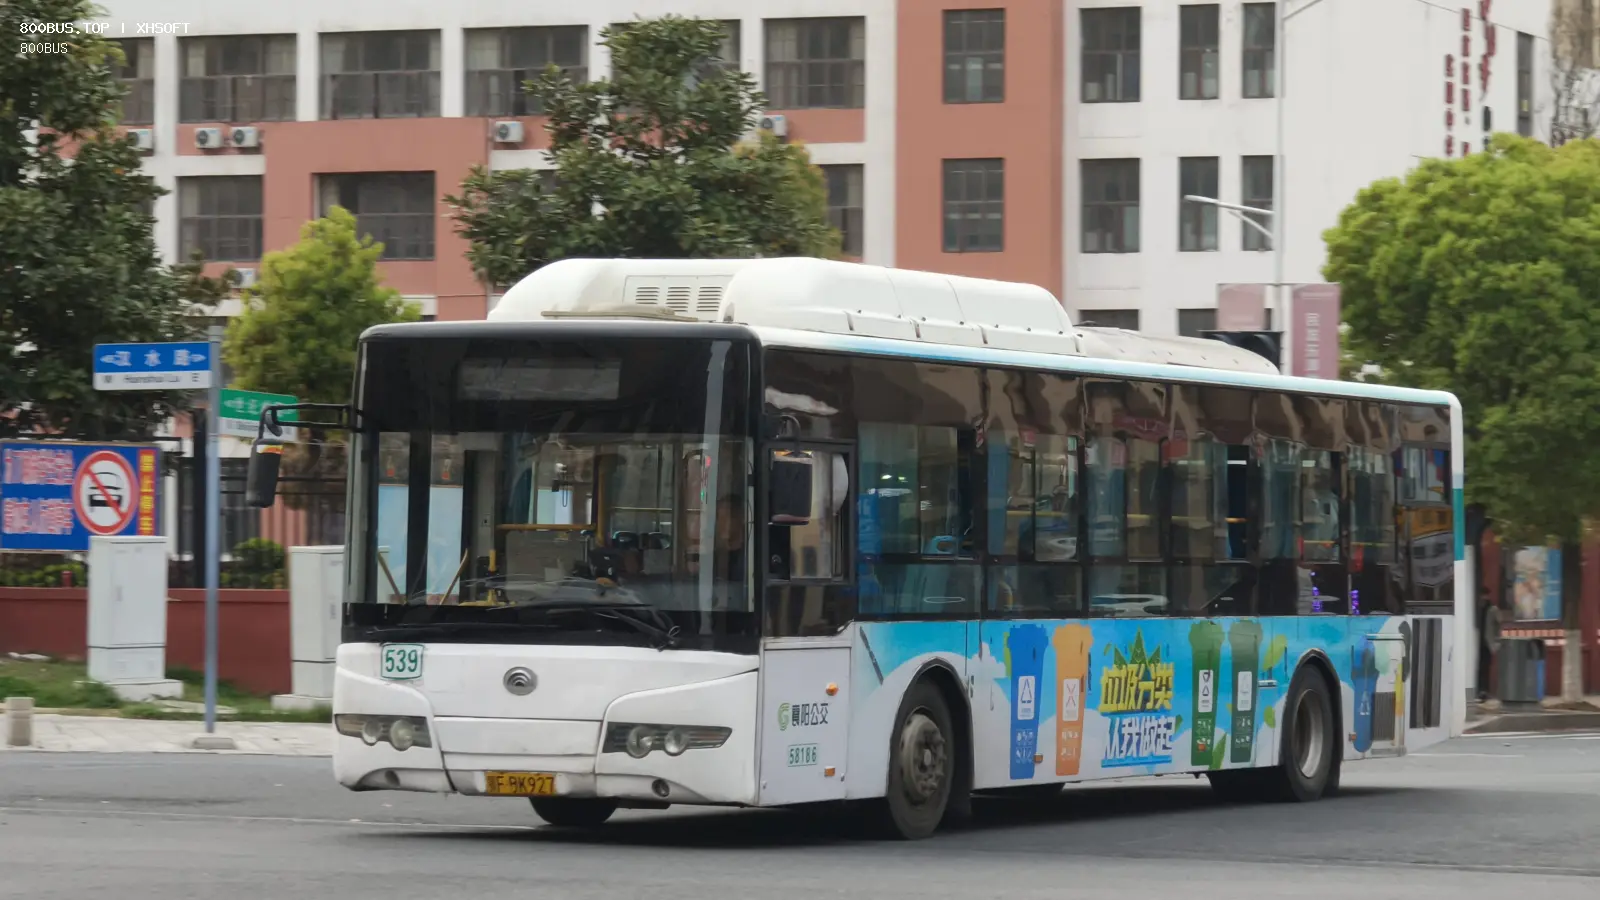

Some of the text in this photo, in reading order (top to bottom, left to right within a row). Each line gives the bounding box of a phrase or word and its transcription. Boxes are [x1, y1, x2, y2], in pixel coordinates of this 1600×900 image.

[385, 649, 417, 673] 539
[1098, 661, 1174, 712] 垃圾分类
[792, 702, 829, 727] 襄阳公交
[1104, 715, 1177, 760] 从我做起
[789, 746, 817, 765] 58186
